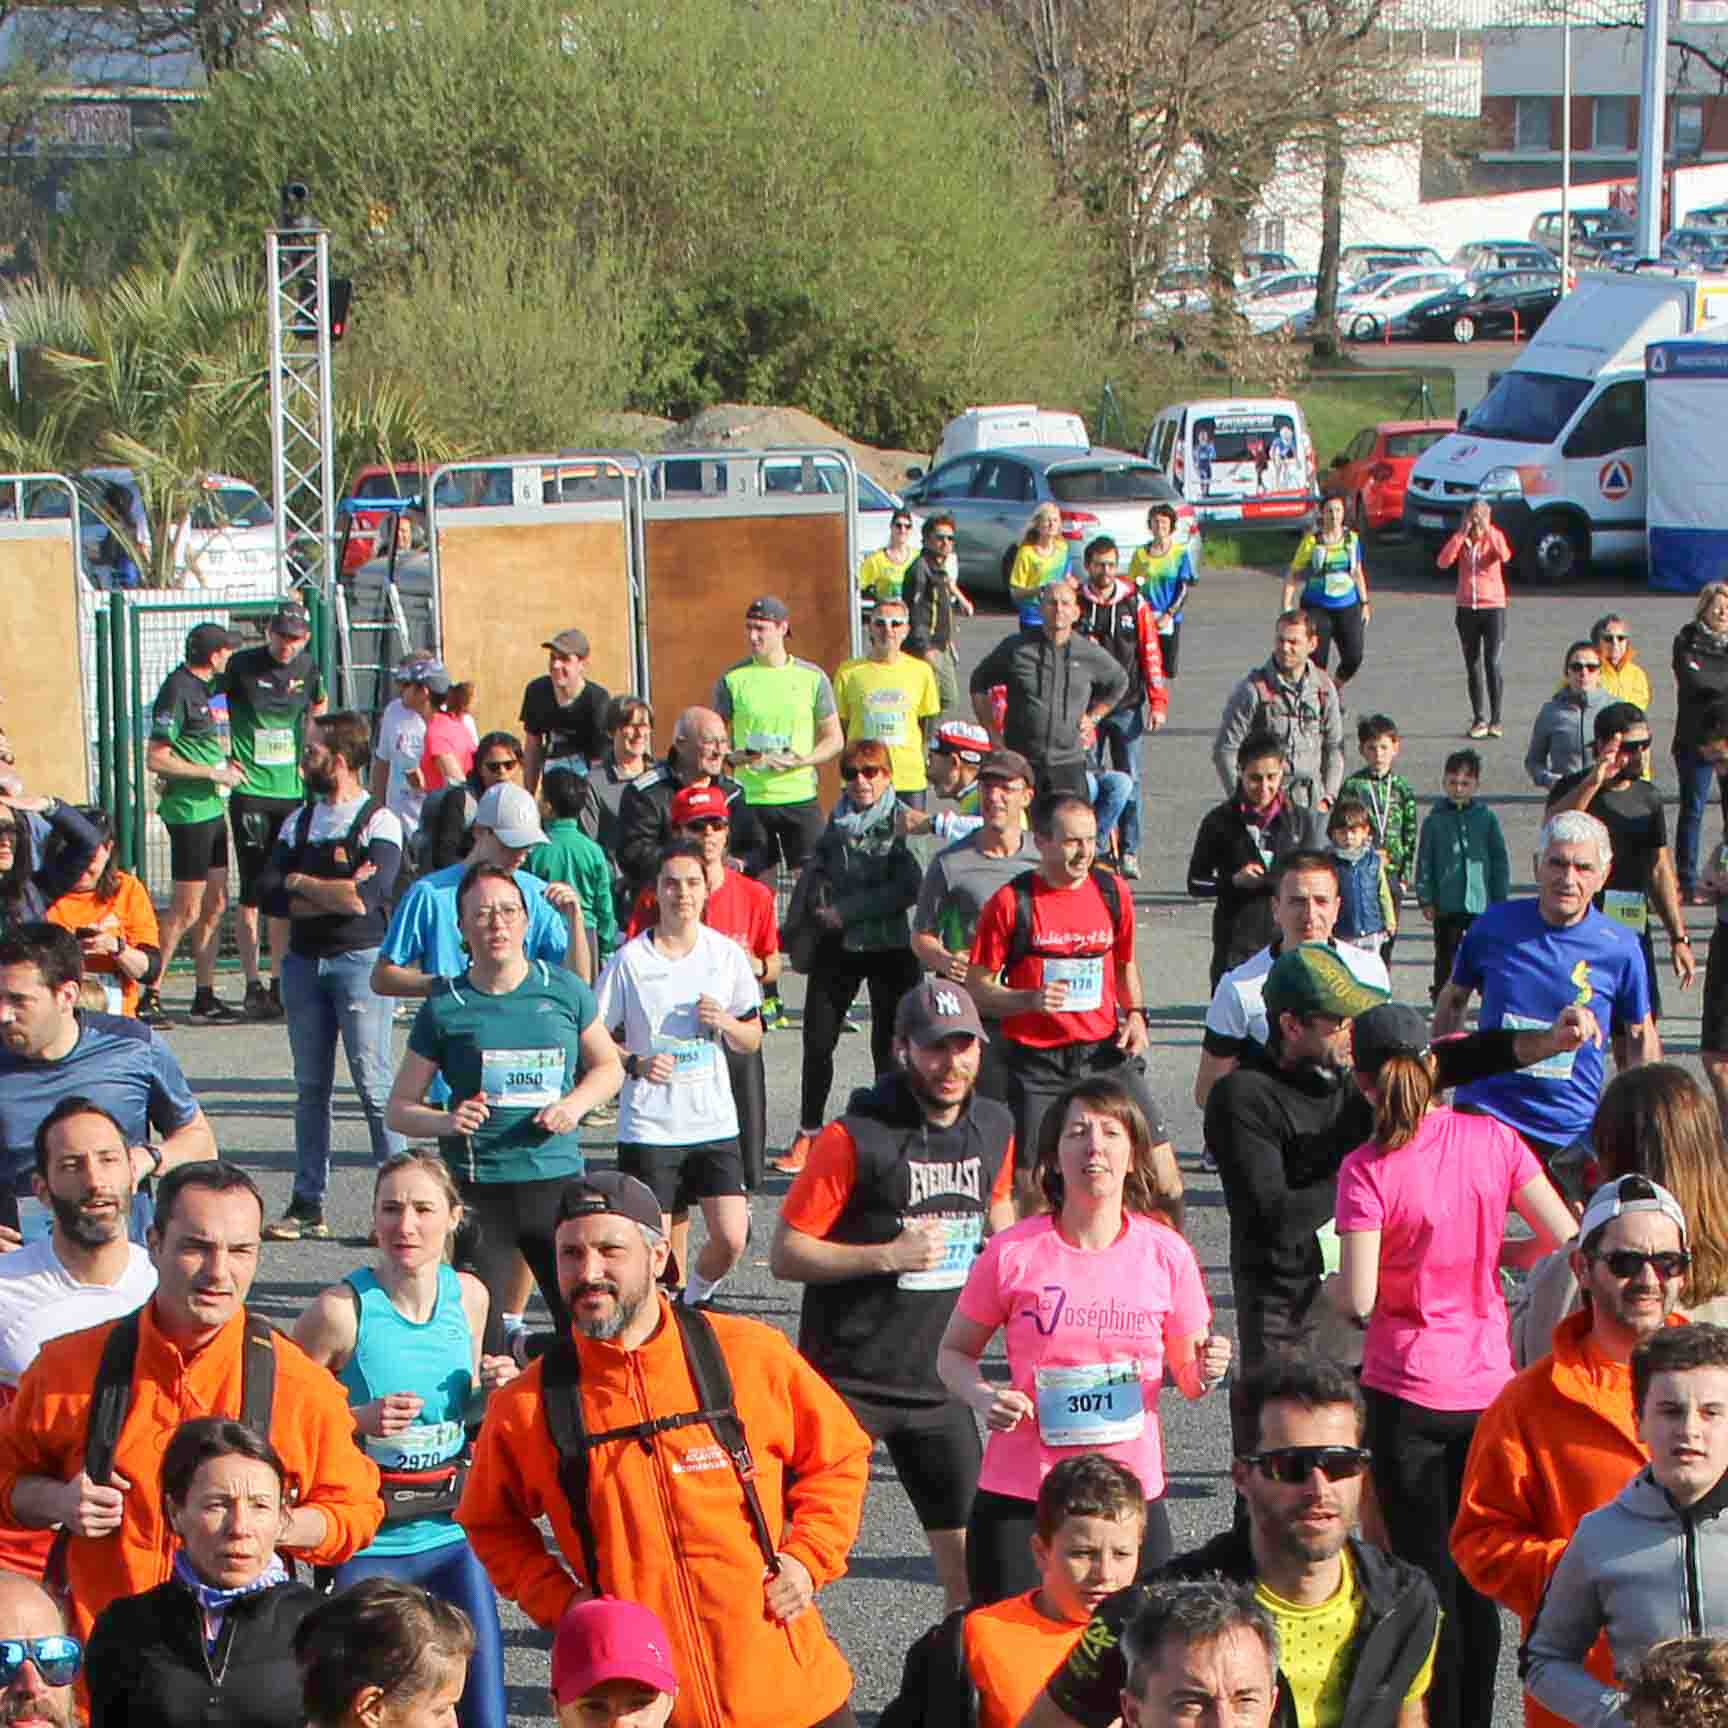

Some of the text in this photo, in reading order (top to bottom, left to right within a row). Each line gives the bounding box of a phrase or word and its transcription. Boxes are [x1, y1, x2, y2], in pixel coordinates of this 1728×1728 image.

[505, 1071, 543, 1086] 3050
[909, 1156, 981, 1206] EVERLAST
[1067, 1393, 1113, 1414] 3071
[397, 1452, 441, 1469] 2970
